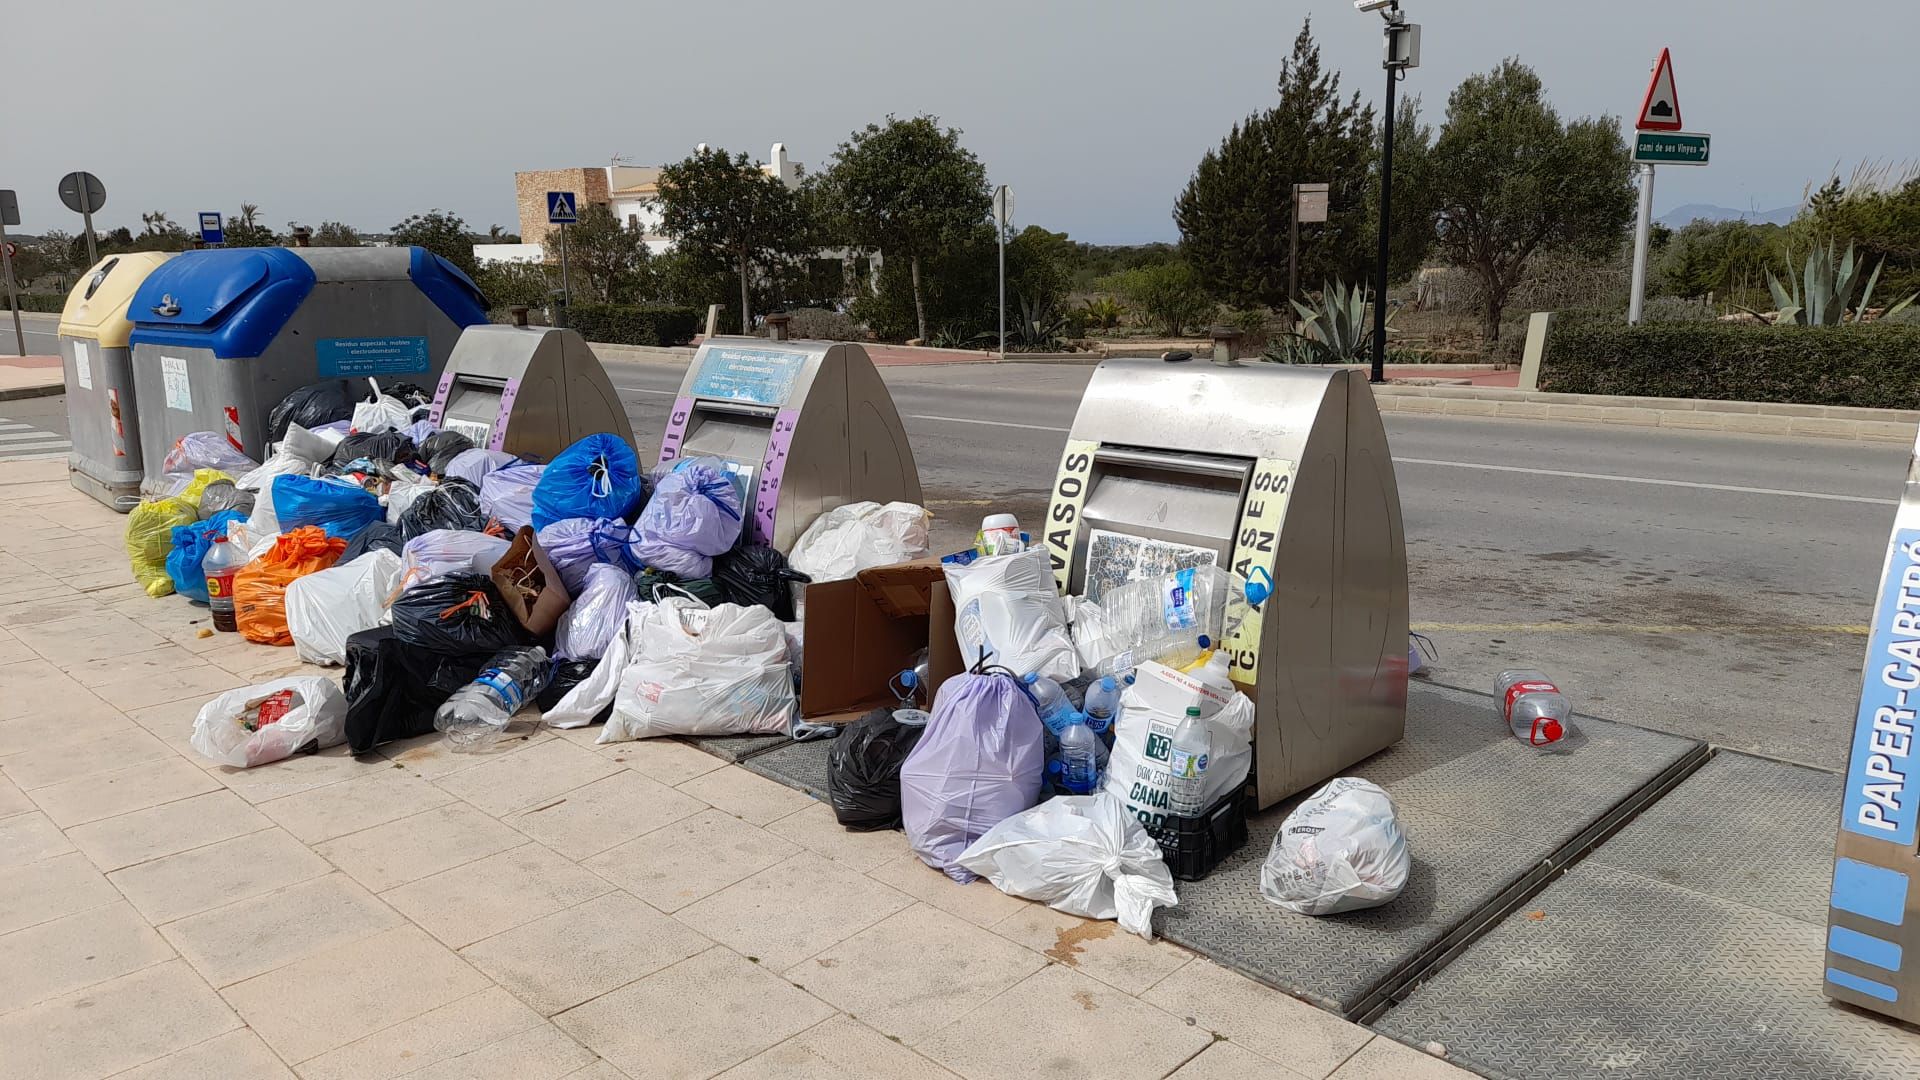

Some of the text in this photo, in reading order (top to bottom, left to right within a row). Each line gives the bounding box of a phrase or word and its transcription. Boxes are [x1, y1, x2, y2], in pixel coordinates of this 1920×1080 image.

[1655, 142, 1663, 153] de
[1665, 145, 1676, 153] ses
[1677, 144, 1697, 154] Vinyes
[755, 421, 784, 547] ECHAZO
[1049, 453, 1089, 588] VASOS
[1239, 474, 1290, 671] CNS
[1136, 764, 1153, 781] CON
[1152, 770, 1171, 788] EST
